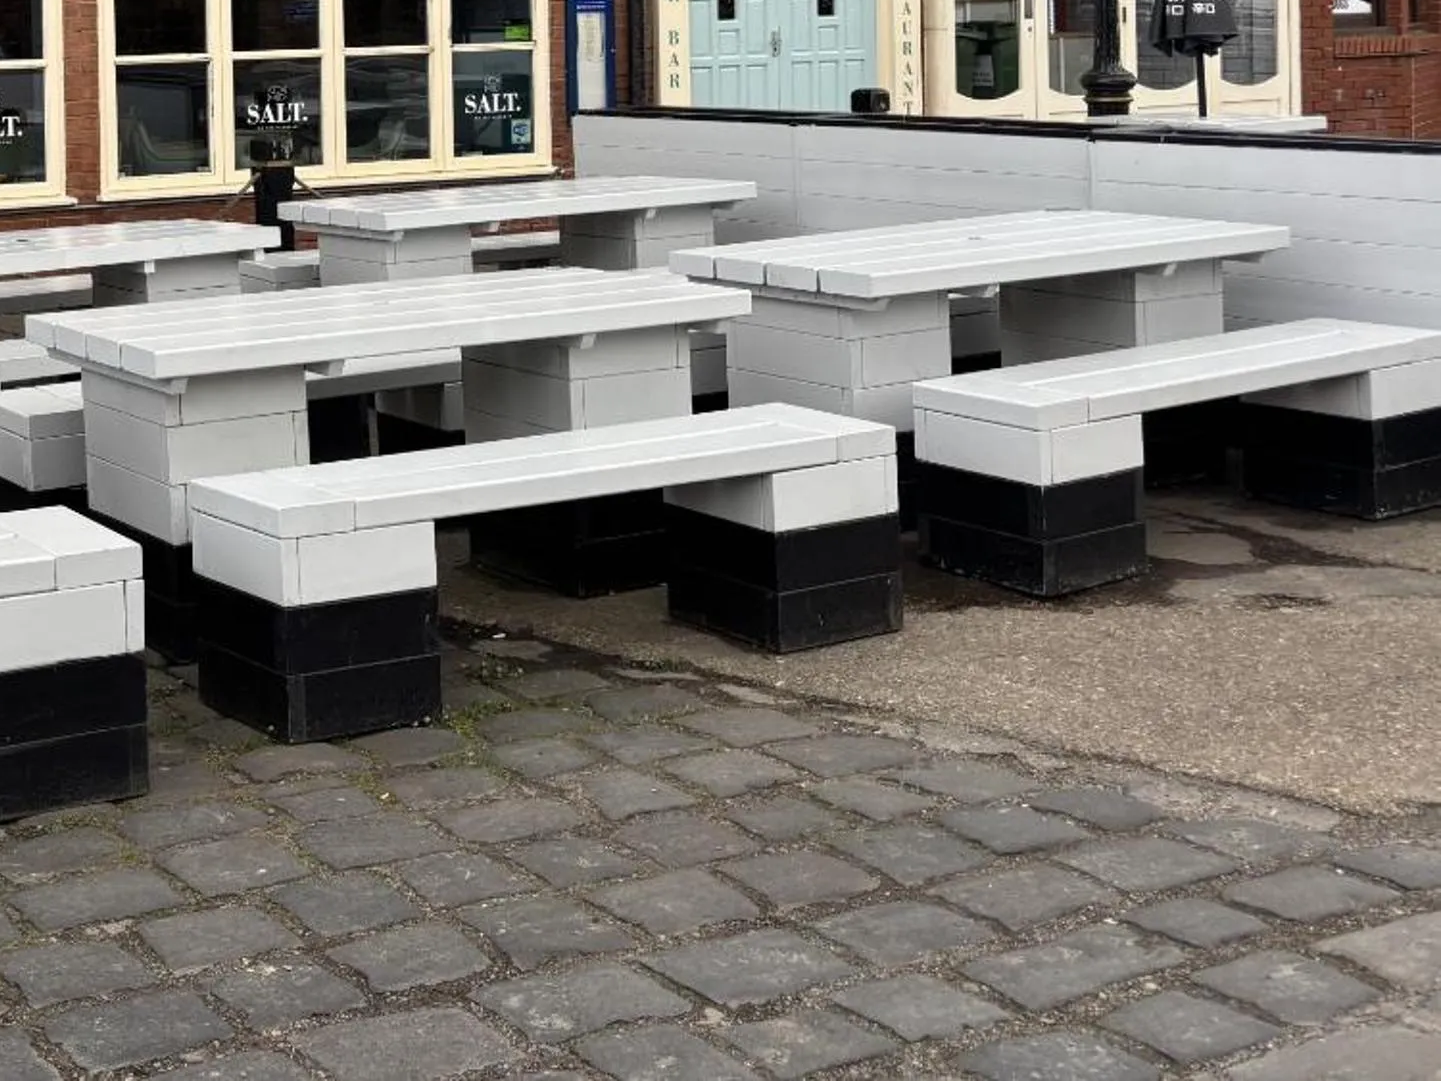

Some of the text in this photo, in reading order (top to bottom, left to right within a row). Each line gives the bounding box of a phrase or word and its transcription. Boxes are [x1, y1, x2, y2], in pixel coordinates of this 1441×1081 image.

[668, 30, 680, 88] BAR
[247, 102, 308, 125] SALT.
[464, 92, 521, 114] SALT.
